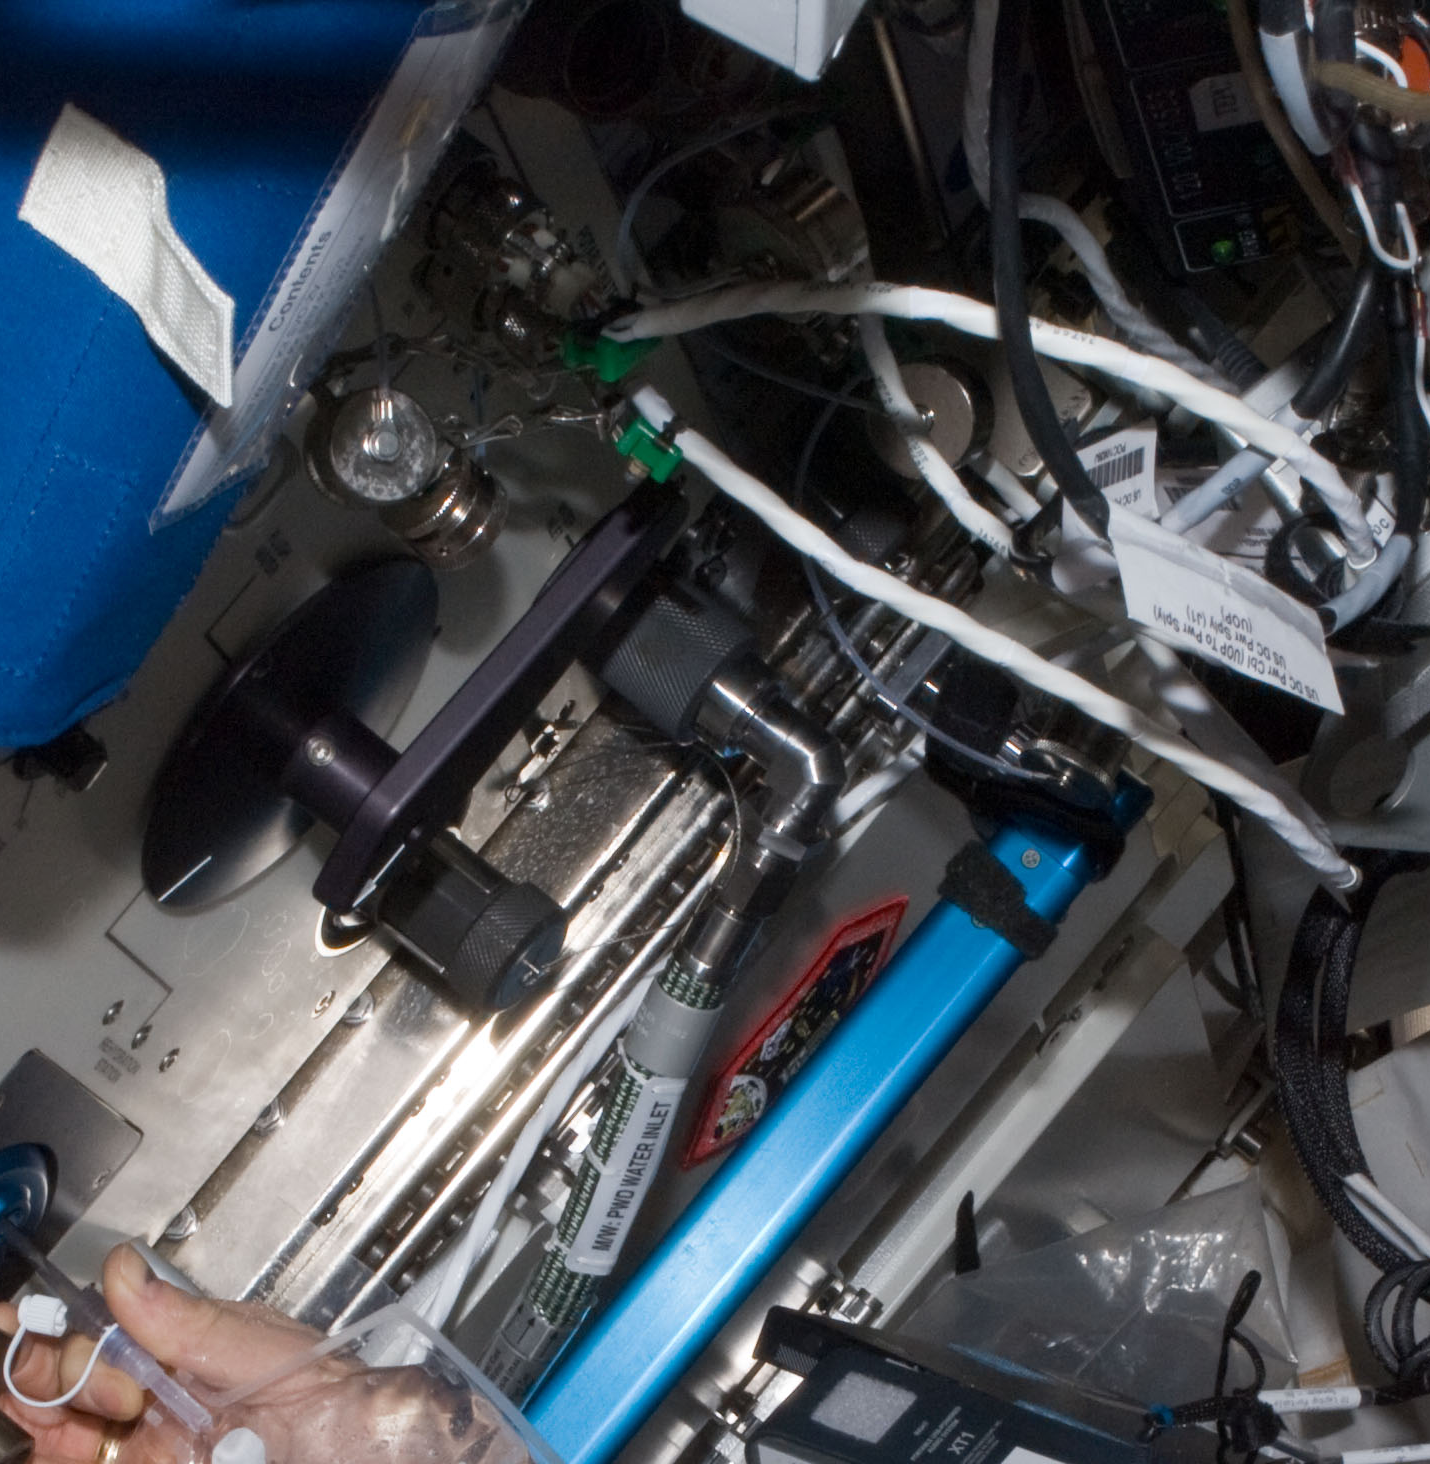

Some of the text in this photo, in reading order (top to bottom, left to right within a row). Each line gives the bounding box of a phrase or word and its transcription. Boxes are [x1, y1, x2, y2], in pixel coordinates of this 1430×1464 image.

[267, 227, 333, 334] Contents
[1208, 616, 1231, 639] Sply
[1219, 605, 1251, 633] (UOP)
[1151, 604, 1319, 701] US DC Pwr Cbl (UOP To Pwr Sply)
[1232, 630, 1253, 649] Pwr
[1254, 642, 1270, 659] DC
[1270, 651, 1286, 668] US
[642, 1100, 672, 1139] INLET
[620, 1138, 655, 1188] WATER
[606, 1186, 635, 1220] PWD
[946, 1430, 975, 1454] XT1
